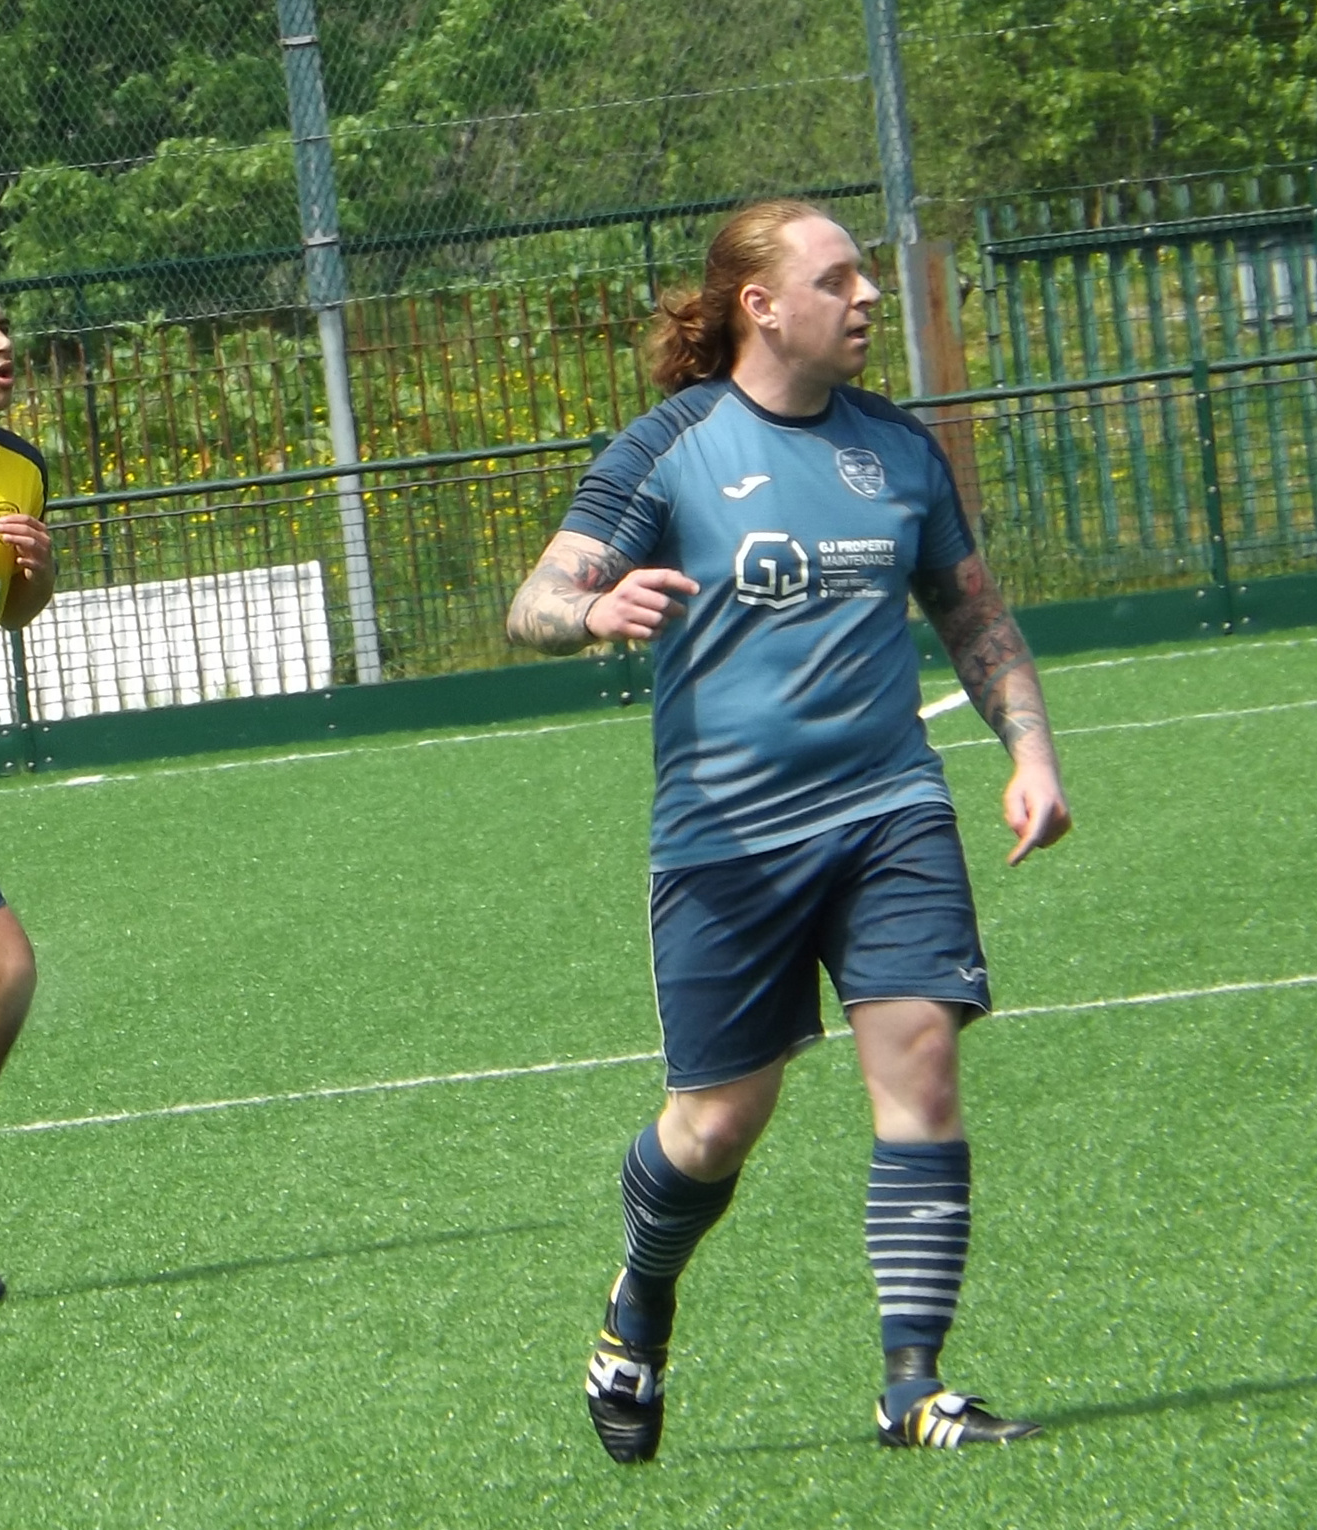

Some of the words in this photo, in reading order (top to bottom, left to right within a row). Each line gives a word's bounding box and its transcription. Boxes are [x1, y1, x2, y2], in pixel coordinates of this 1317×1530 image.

[819, 542, 835, 553] GJ
[837, 540, 895, 553] PROPERTY
[822, 555, 896, 566] MAINTENANCE
